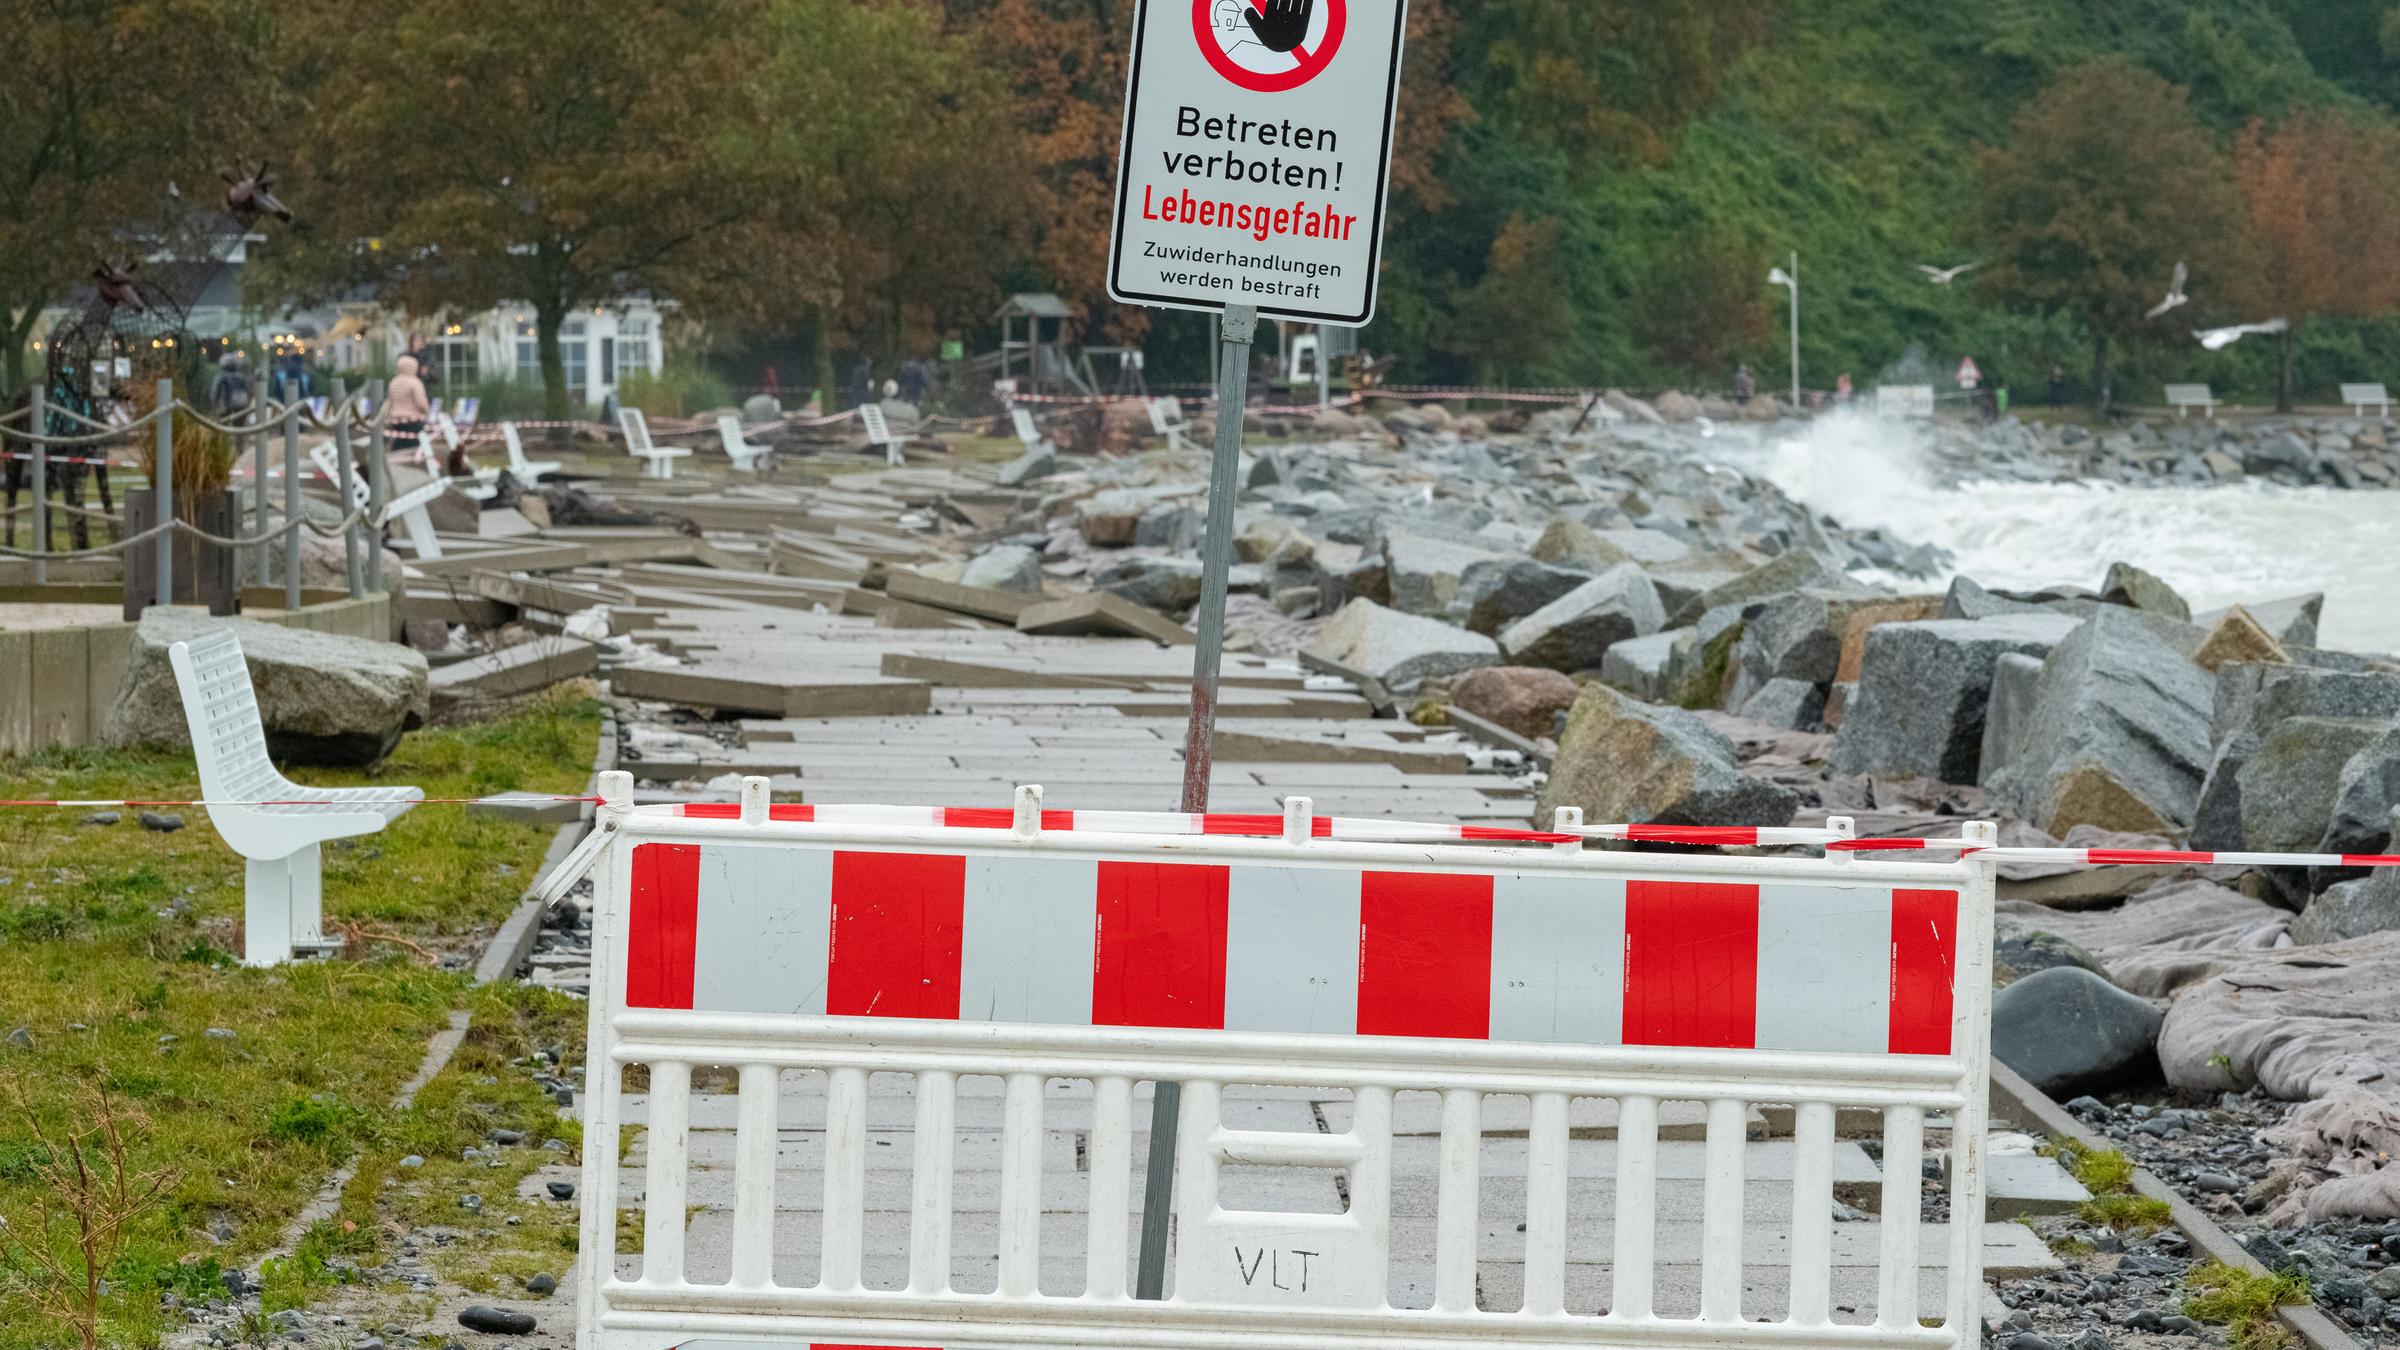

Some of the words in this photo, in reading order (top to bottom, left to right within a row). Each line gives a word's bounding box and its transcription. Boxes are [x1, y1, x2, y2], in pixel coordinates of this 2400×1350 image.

[1176, 106, 1337, 152] Betreten
[1163, 150, 1343, 191] verboten!
[1143, 185, 1357, 241] Lebensgefahr
[1144, 241, 1341, 278] Zuwiderhandlungen
[1160, 270, 1234, 290] werden
[1241, 276, 1320, 299] bestraft
[1235, 1247, 1319, 1292] VLT
